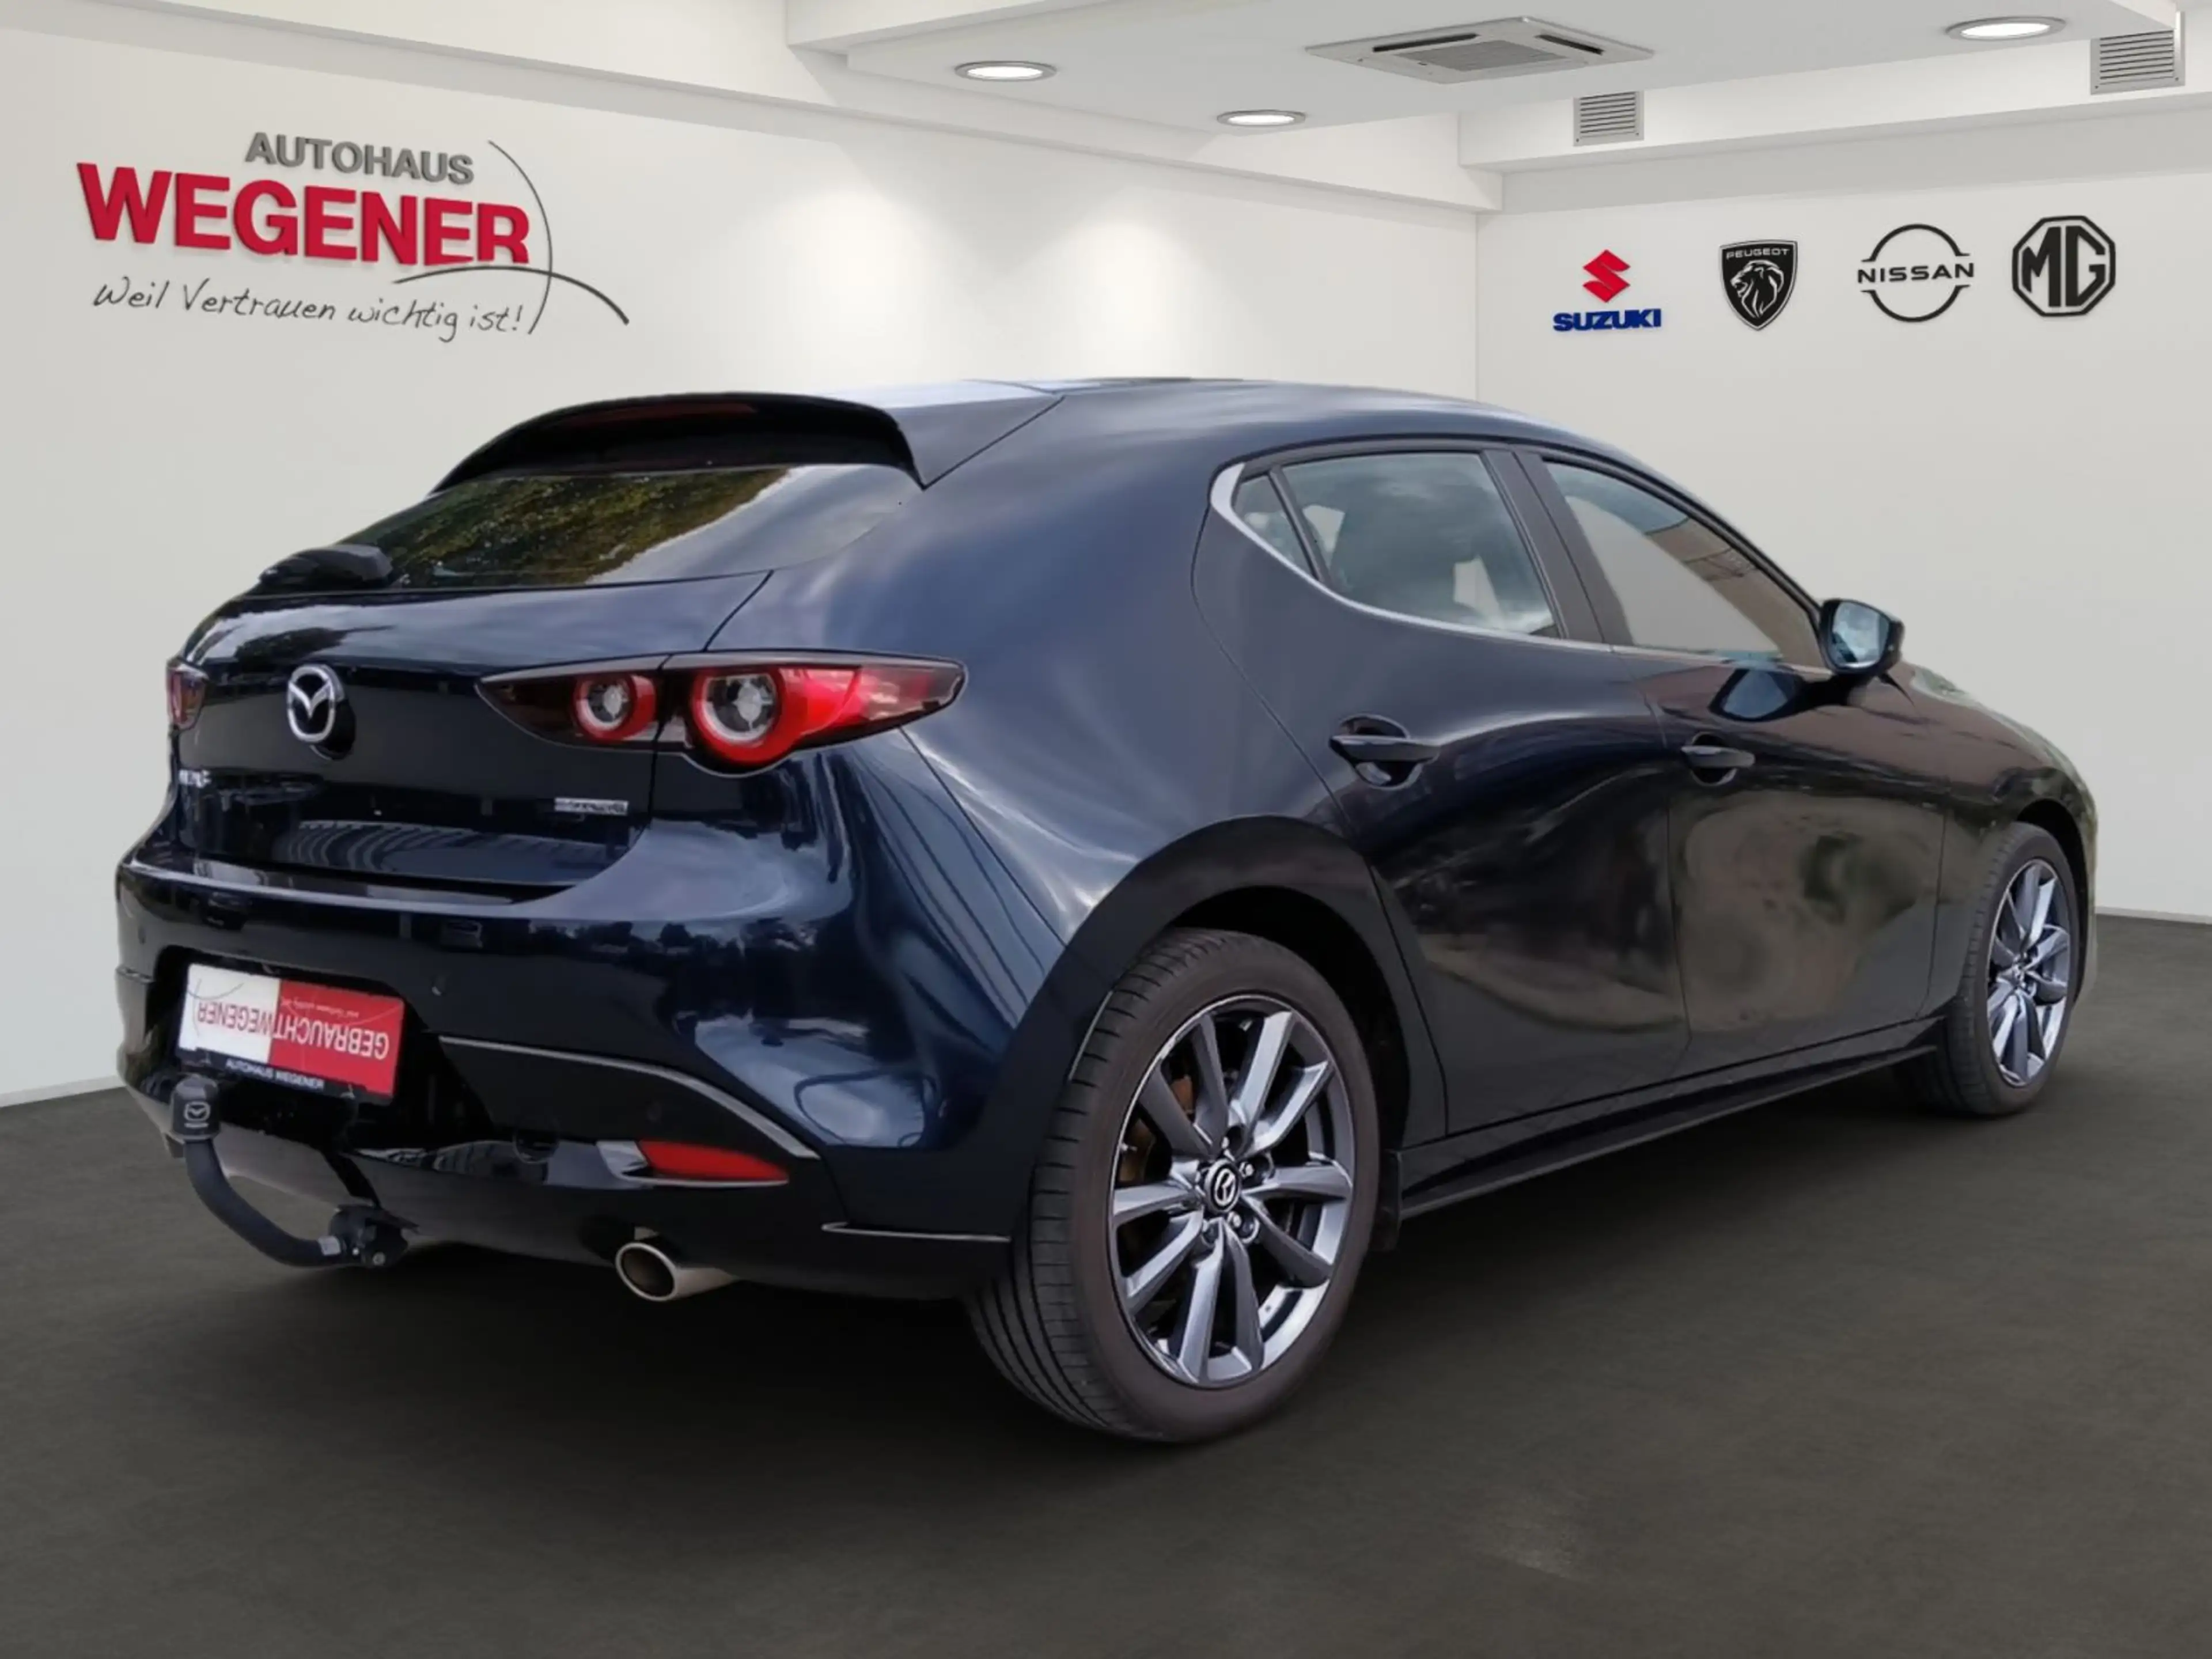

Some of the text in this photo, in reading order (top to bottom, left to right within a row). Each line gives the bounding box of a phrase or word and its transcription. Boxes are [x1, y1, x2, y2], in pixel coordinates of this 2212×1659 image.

[244, 132, 475, 185] AUTOHAUS
[77, 161, 531, 267] WEGENER
[1726, 248, 1789, 259] PEUGEOT
[1857, 262, 1975, 284] NISSAN
[2021, 225, 2107, 308] MG
[93, 275, 523, 343] Weil Vertrauen wichtig ist!
[1553, 308, 1663, 332] SUZUKI
